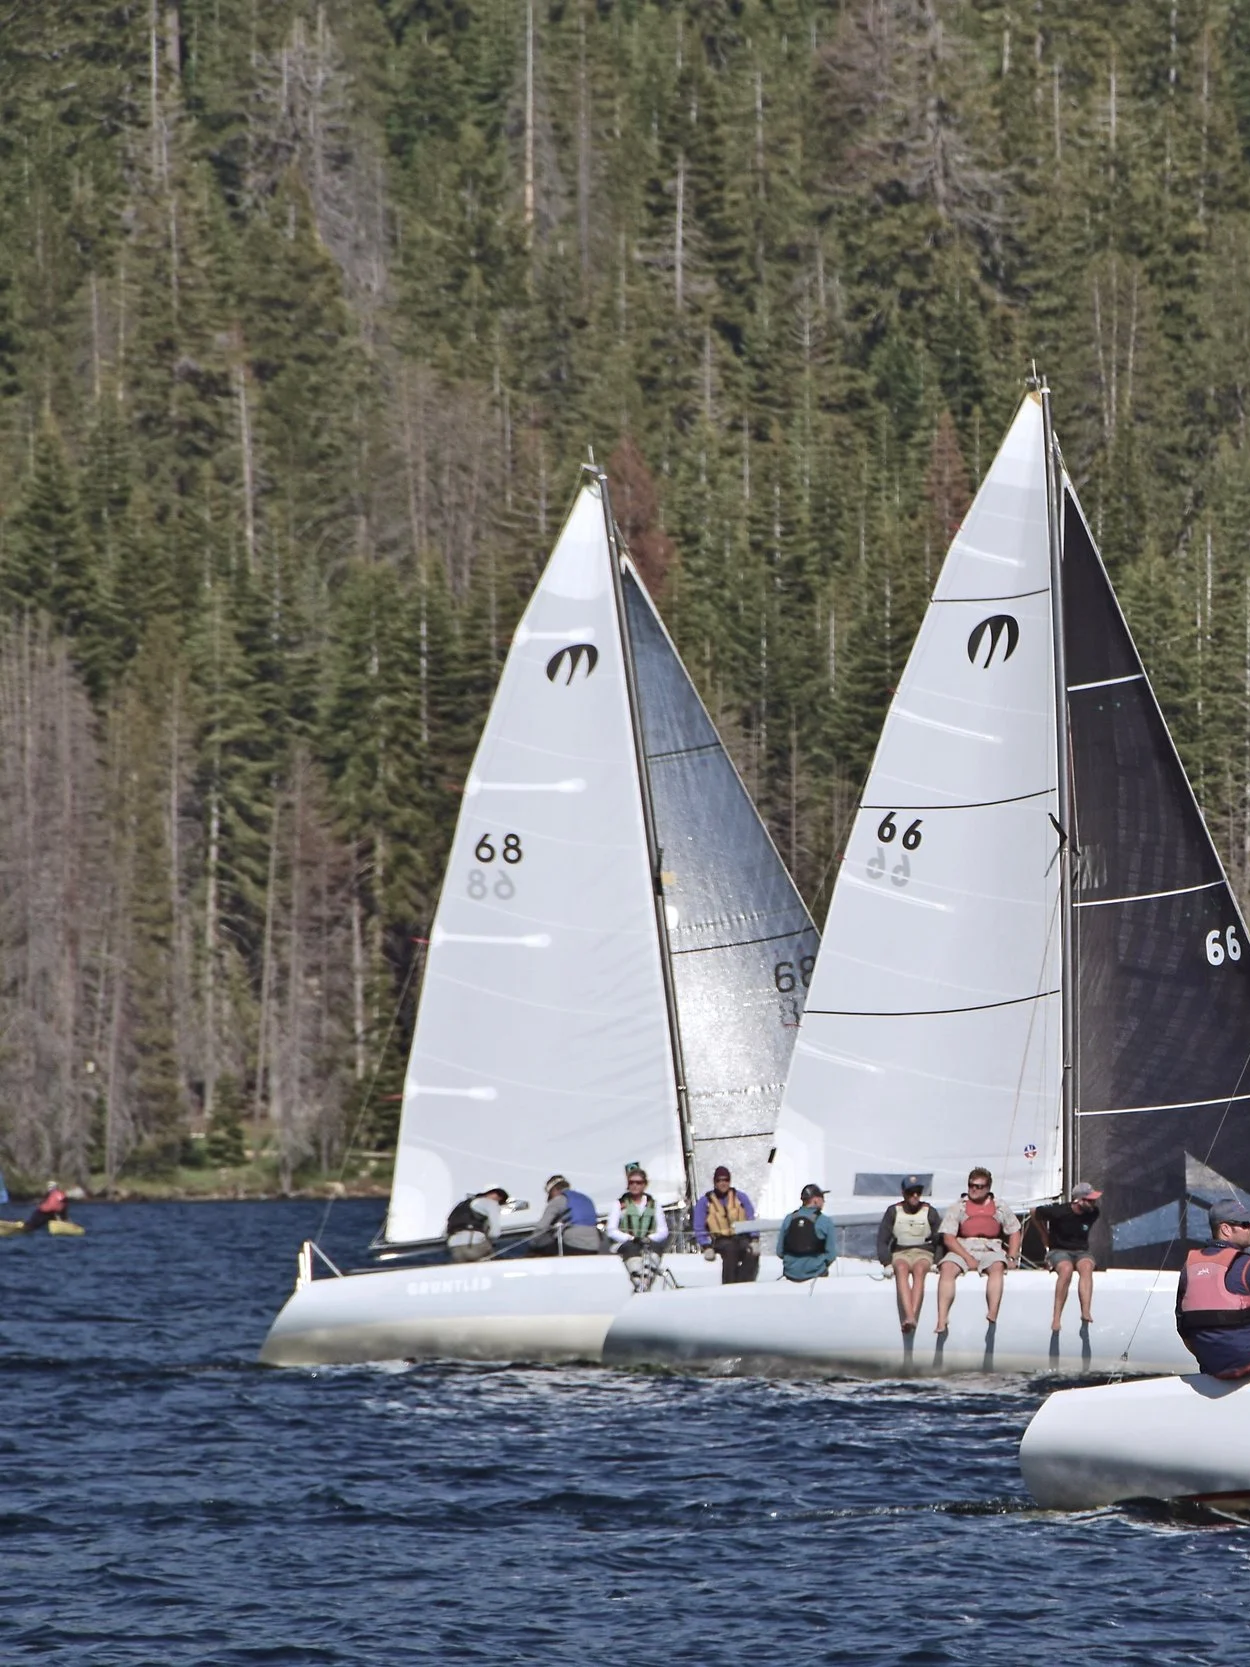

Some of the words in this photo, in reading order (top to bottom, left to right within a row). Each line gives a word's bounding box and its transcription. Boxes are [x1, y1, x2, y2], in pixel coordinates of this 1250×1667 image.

[475, 833, 523, 864] 68
[877, 811, 924, 851] 66
[1205, 925, 1242, 966] 66
[774, 955, 817, 993] 68
